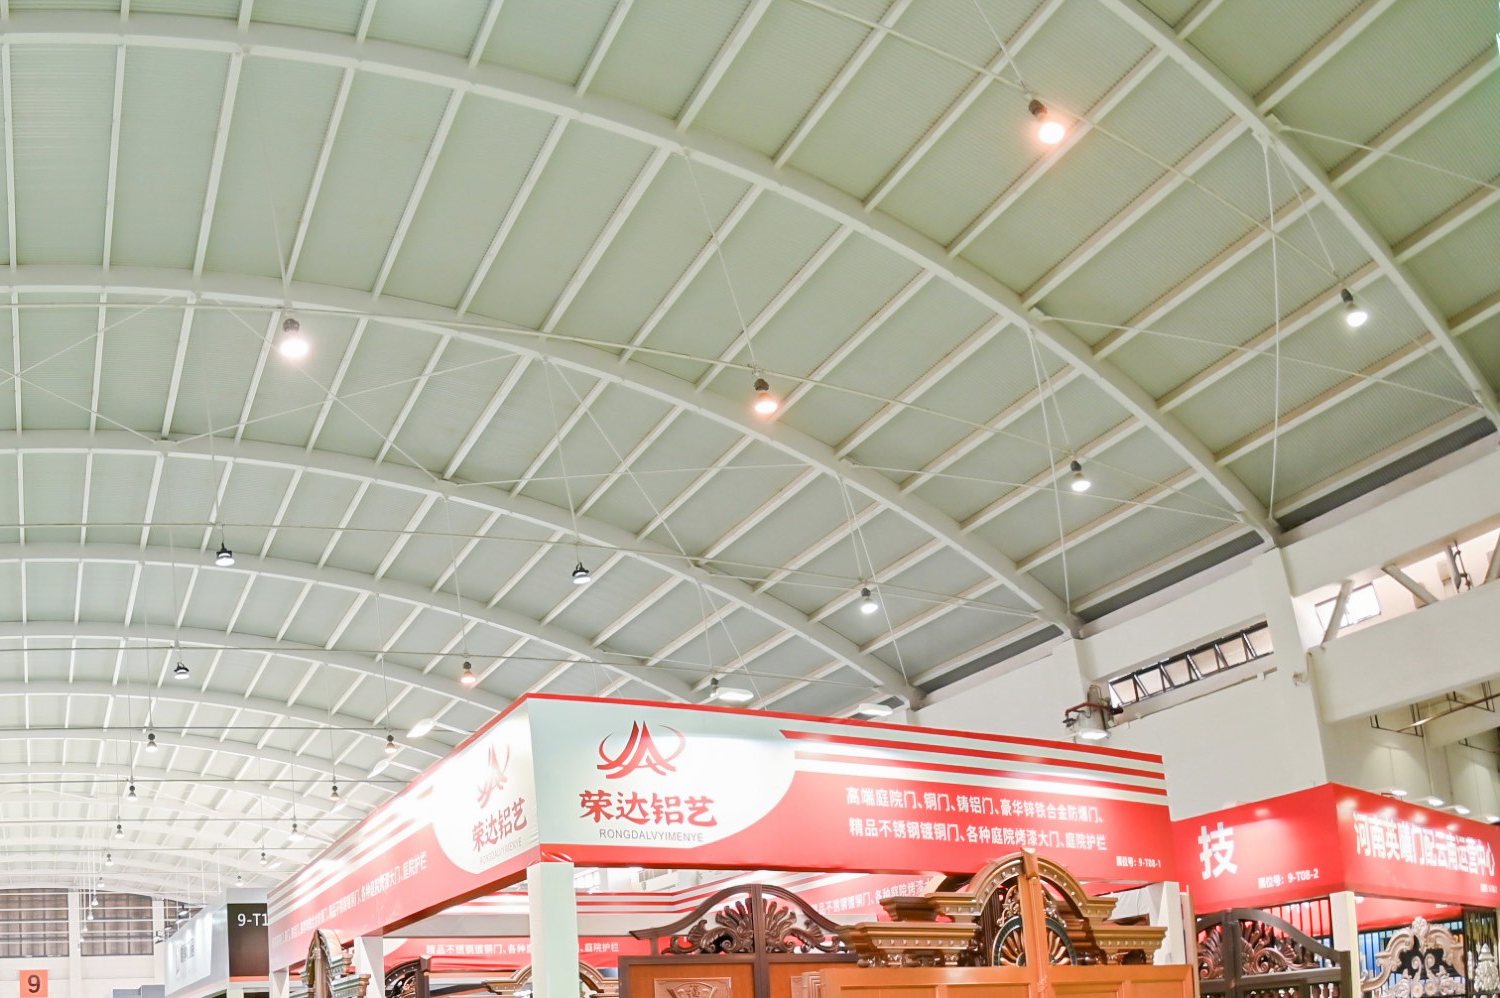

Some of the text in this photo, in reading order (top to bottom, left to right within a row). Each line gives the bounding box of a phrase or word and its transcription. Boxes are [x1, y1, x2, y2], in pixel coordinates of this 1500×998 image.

[471, 797, 528, 854] 荣达铝艺
[578, 787, 718, 829] 荣达铝艺
[598, 828, 704, 843] RONGDALVYIMENYE
[1197, 821, 1238, 880] 技
[27, 974, 41, 993] 9
